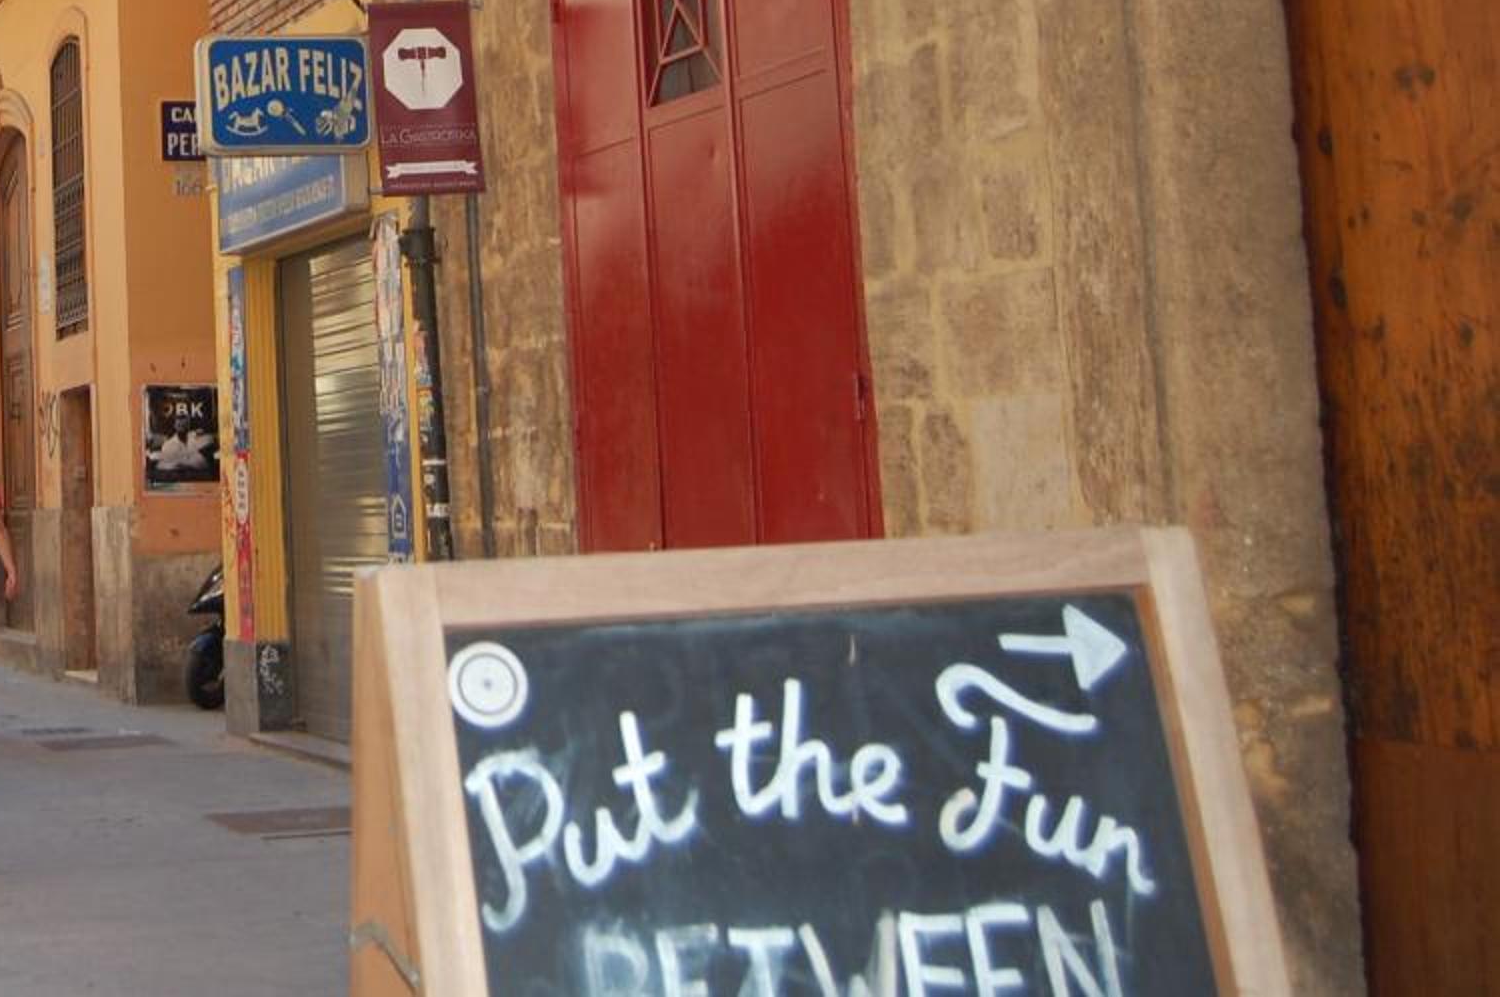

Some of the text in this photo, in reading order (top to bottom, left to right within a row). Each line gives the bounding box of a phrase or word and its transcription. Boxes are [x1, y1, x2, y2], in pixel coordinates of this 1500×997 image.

[213, 47, 363, 111] BAZAR FELIZ
[465, 711, 698, 932] Put
[714, 678, 907, 826] the
[580, 900, 1125, 997] BETWEEN
